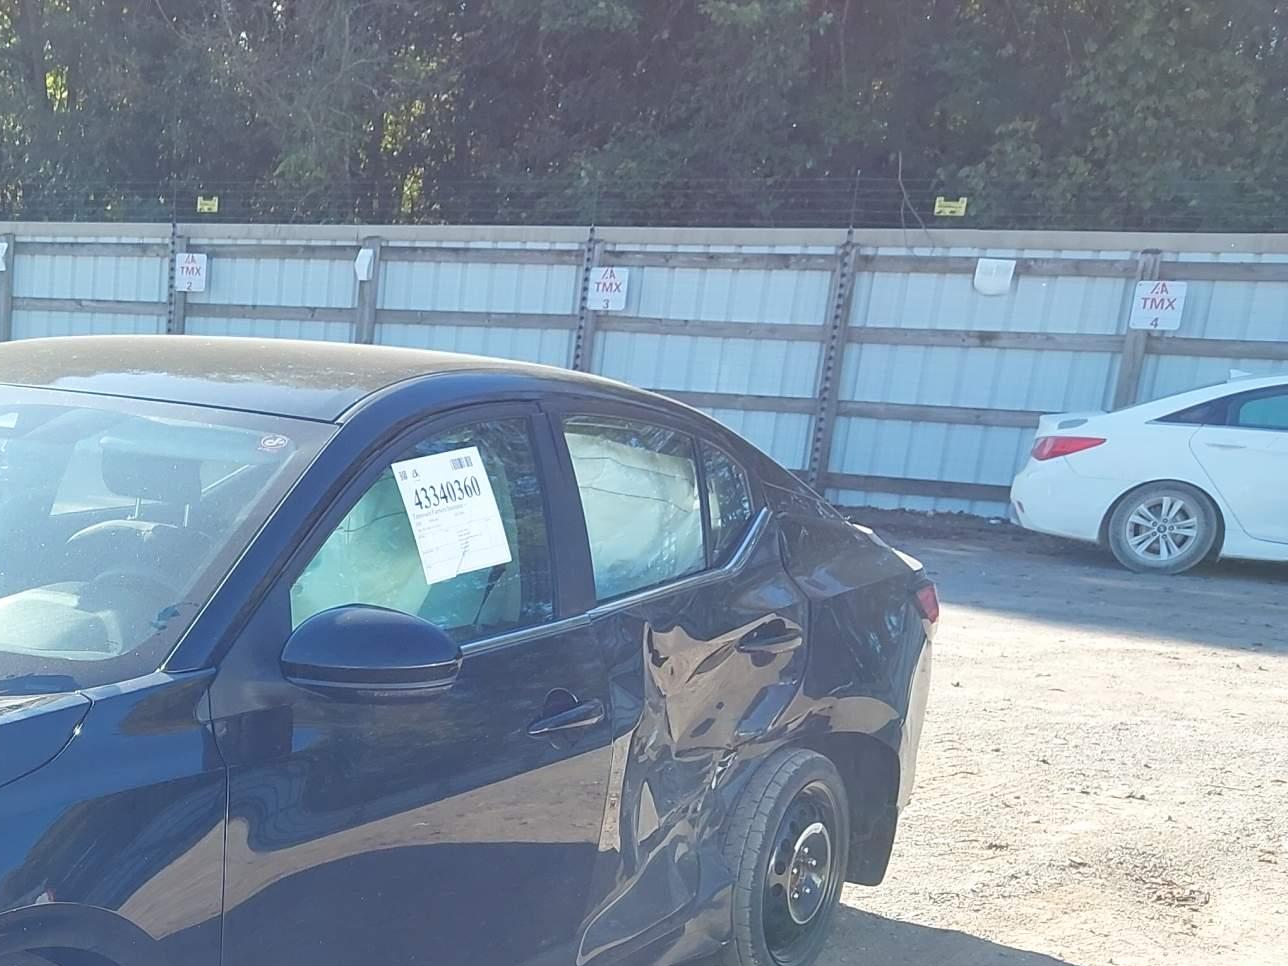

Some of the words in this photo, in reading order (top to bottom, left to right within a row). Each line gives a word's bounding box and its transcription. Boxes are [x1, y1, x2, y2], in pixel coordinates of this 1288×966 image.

[180, 266, 202, 277] TMX
[186, 281, 193, 290] 2
[595, 282, 622, 293] TMX
[602, 299, 609, 309] 3
[1141, 297, 1177, 310] TMX
[1150, 317, 1159, 328] 4
[414, 475, 481, 510] 43340360
